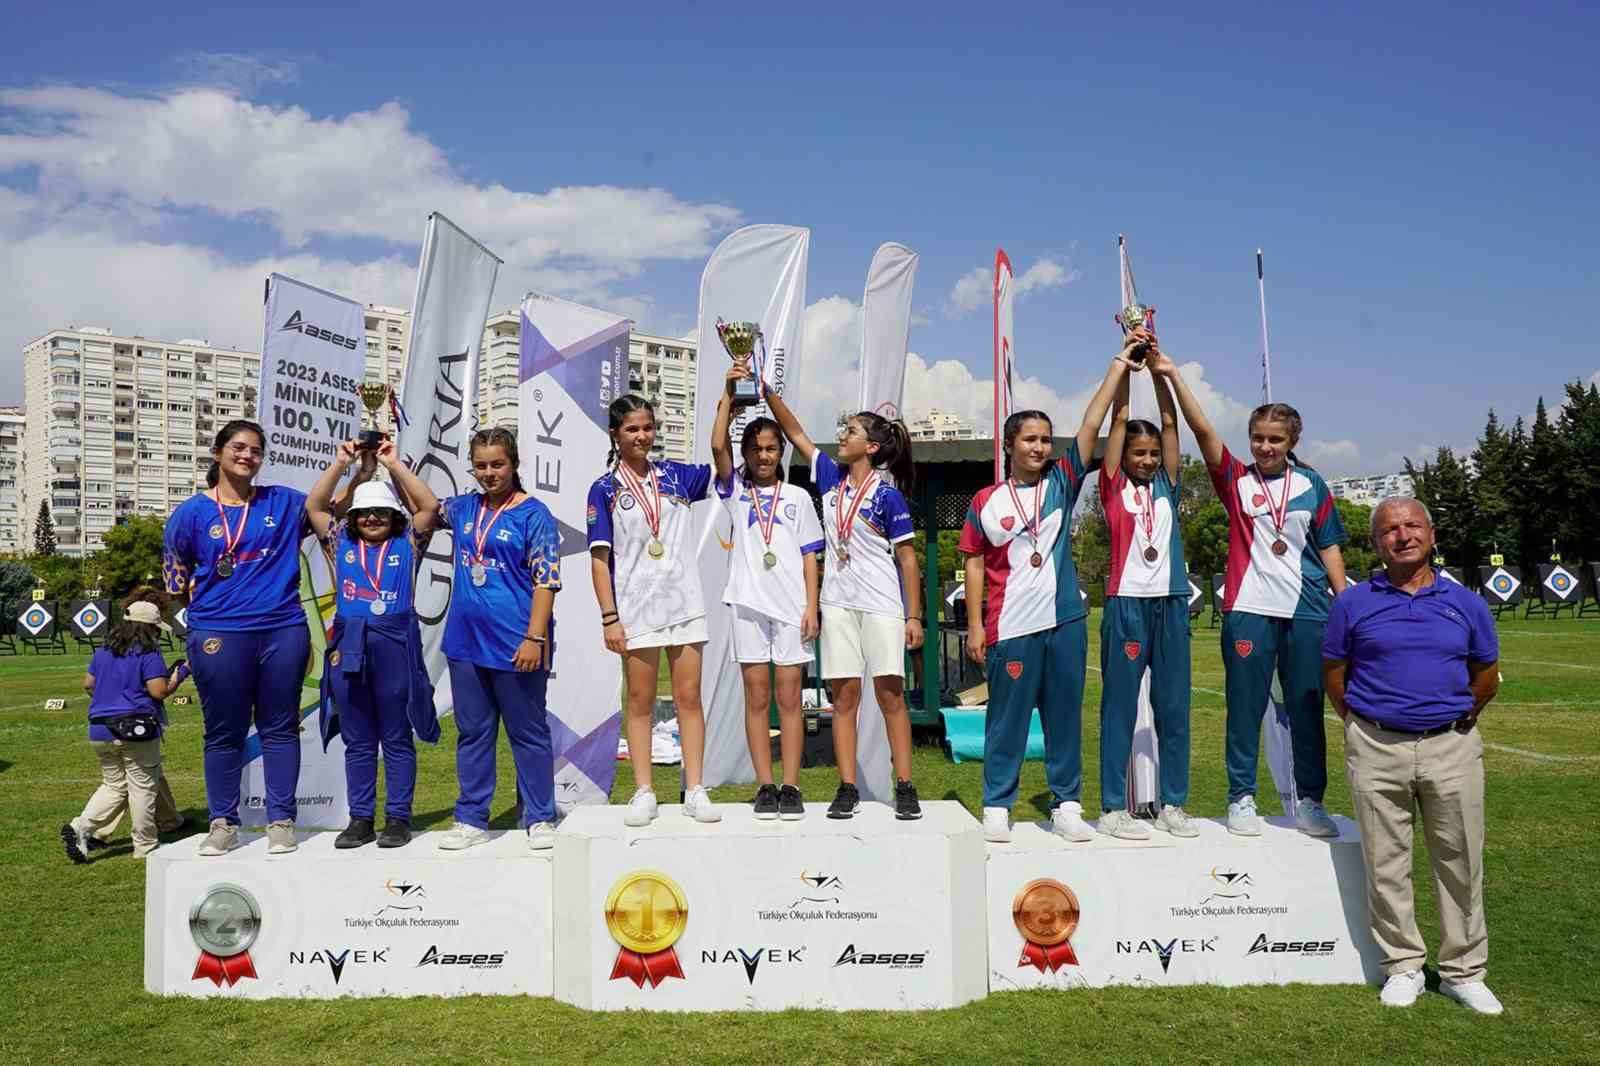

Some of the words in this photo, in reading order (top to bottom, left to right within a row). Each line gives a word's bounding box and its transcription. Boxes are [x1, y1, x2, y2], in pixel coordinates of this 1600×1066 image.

[276, 359, 318, 383] 2023
[320, 371, 358, 393] ASES
[275, 382, 356, 417] MİNİKLER
[273, 405, 320, 434] 100.
[325, 417, 353, 441] YIL
[409, 917, 460, 929] Federasyonu
[758, 910, 789, 922] Türkiye
[789, 910, 824, 922] Okçuluk
[825, 910, 878, 922] Federasyonu
[1169, 906, 1200, 918] Türkiye
[1201, 905, 1235, 917] Okçuluk
[1236, 904, 1289, 916] Federasyonu
